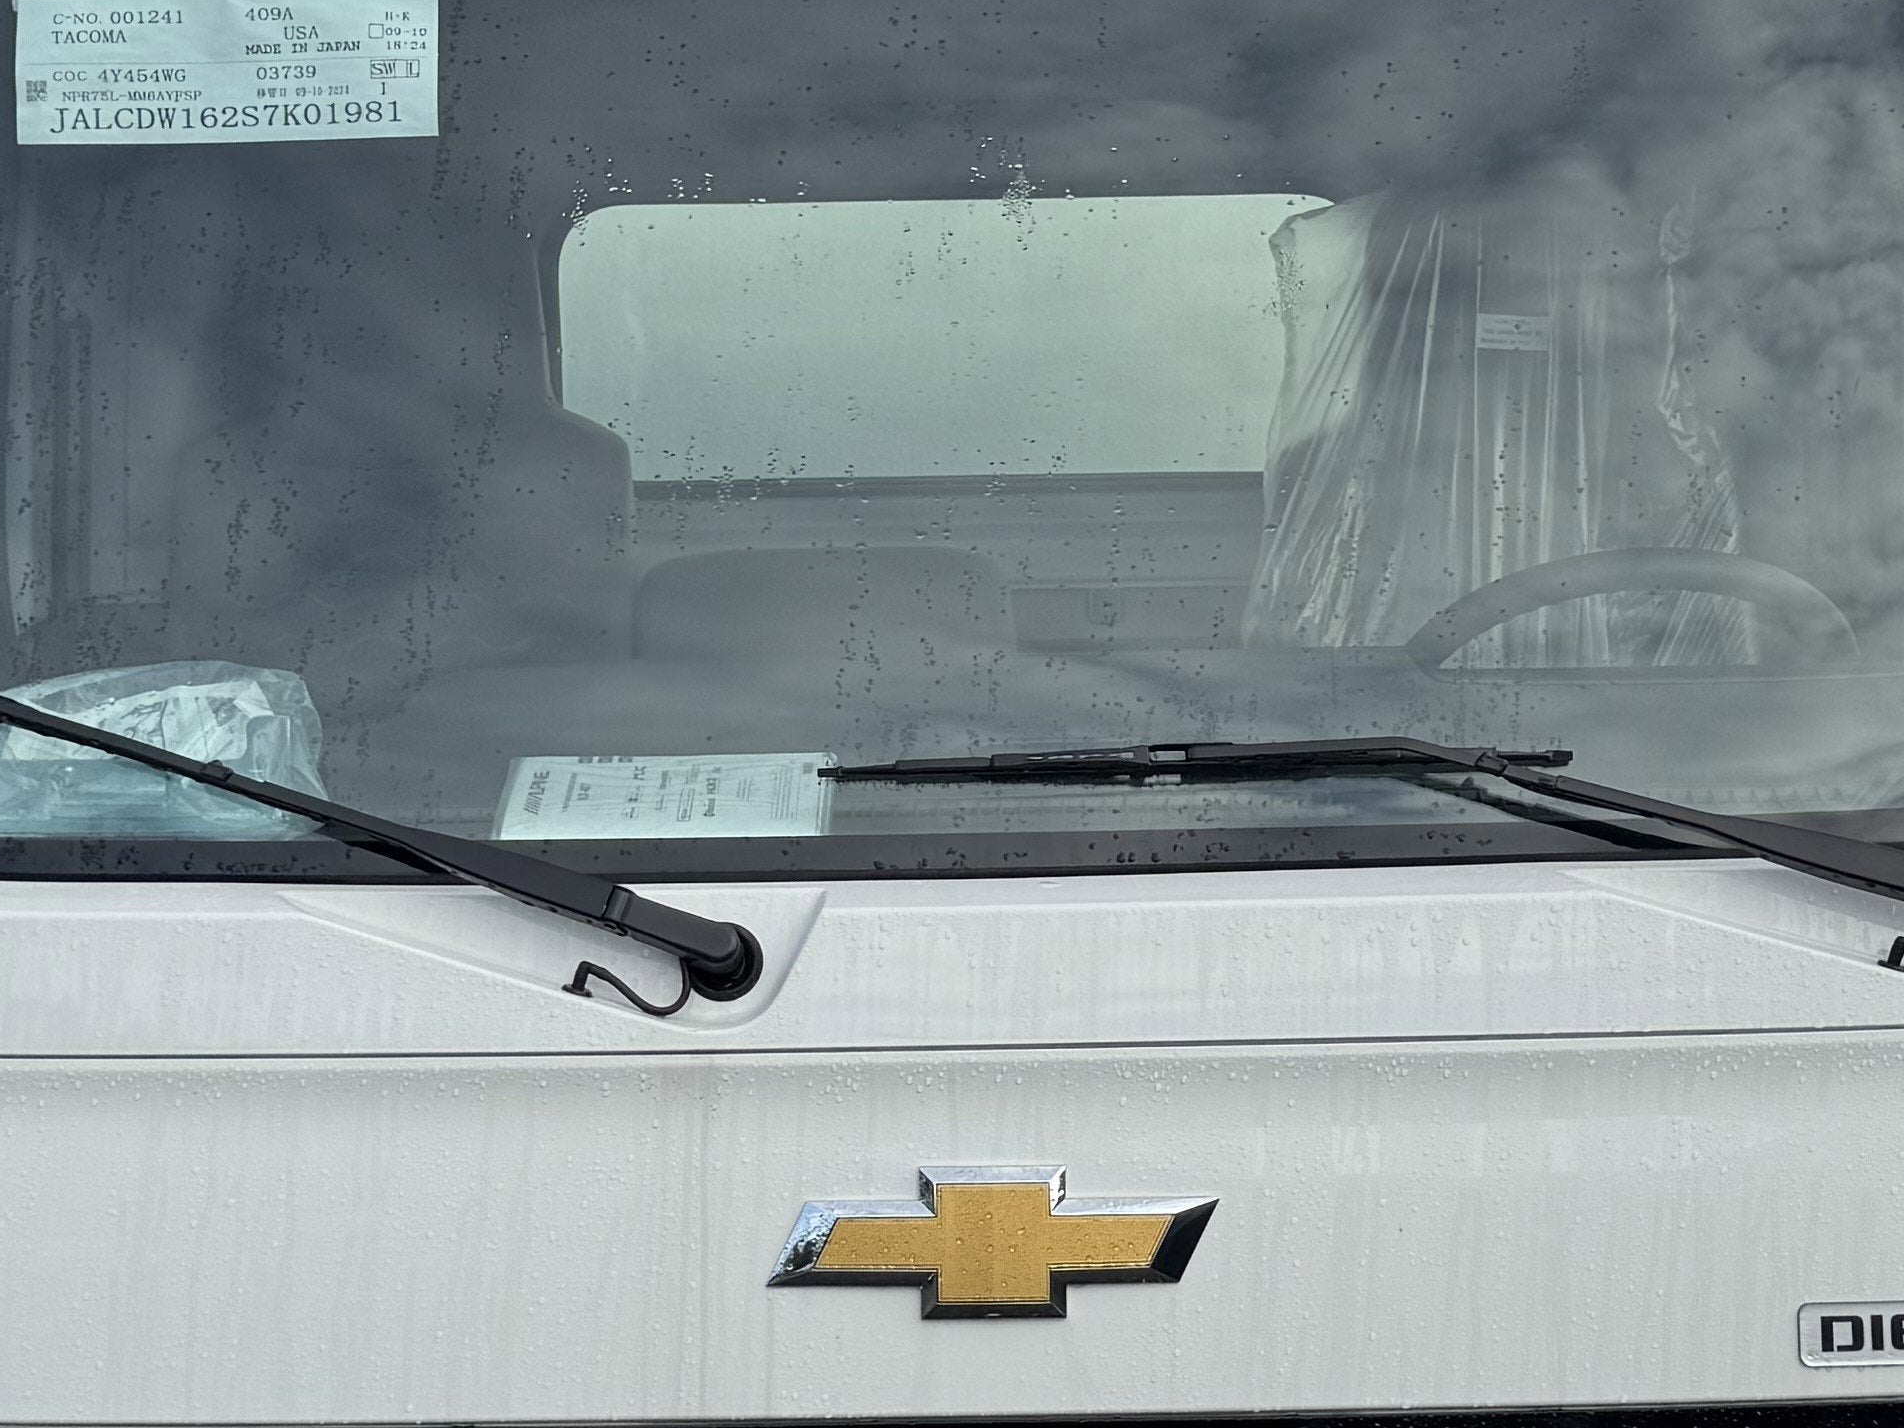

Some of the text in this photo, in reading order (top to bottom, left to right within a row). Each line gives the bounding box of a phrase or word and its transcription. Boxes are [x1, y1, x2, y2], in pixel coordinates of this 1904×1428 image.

[110, 10, 184, 24] 001241
[51, 30, 127, 44] TACOMA
[283, 26, 319, 40] USA
[245, 41, 361, 55] MADE IN JAPAN
[256, 65, 317, 80] 03739
